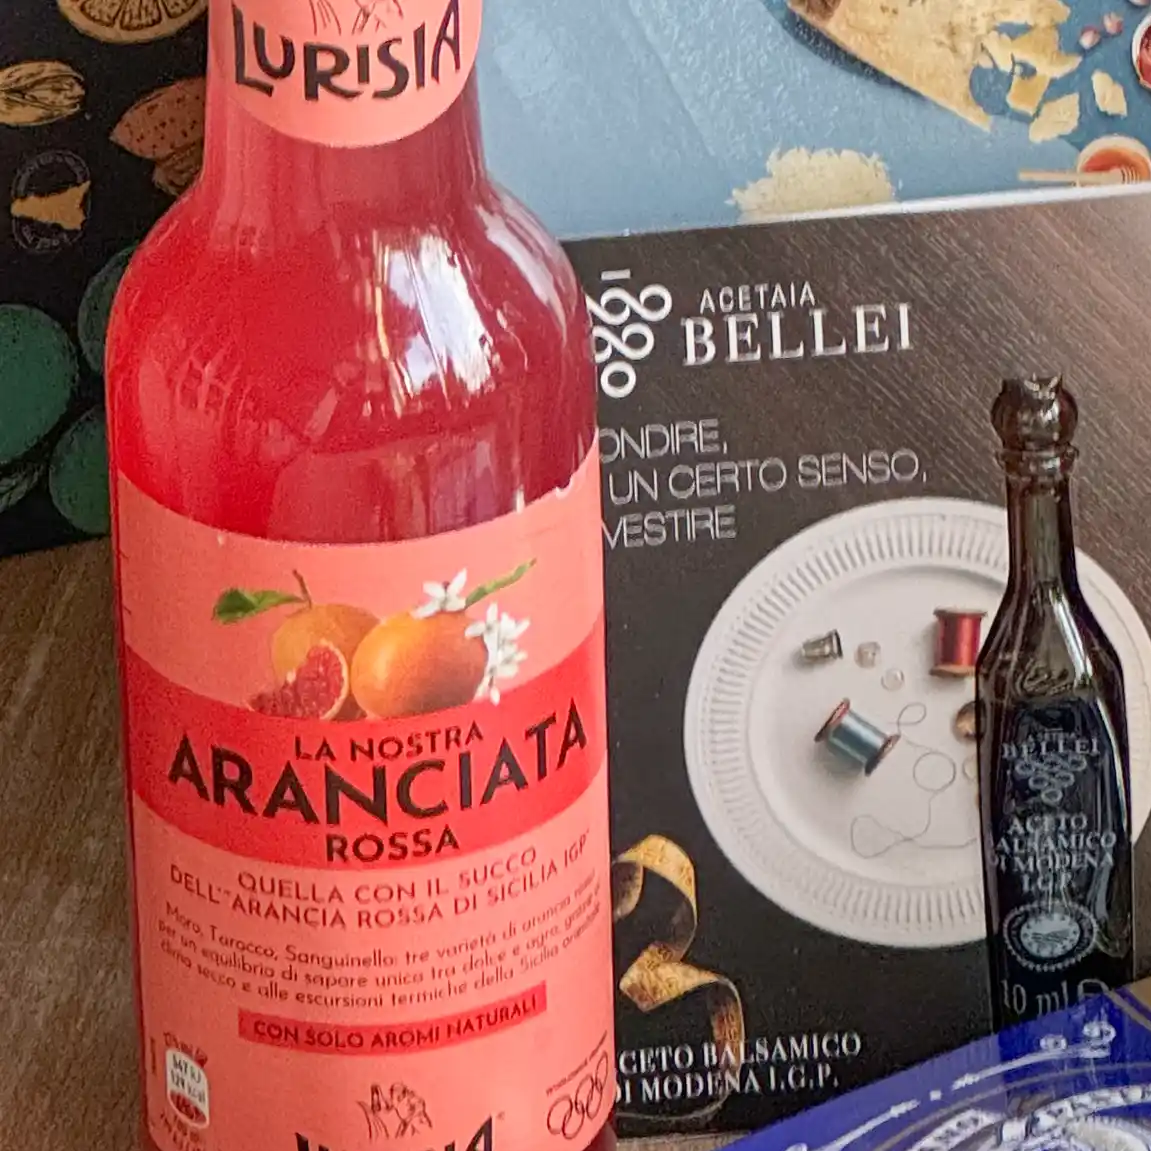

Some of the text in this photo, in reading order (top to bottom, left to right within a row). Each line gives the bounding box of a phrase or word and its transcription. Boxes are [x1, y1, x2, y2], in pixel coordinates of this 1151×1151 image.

[231, 0, 460, 101] LURISIA
[700, 280, 816, 314] ACETAIA
[681, 303, 912, 366] BELLEI
[609, 448, 927, 505] UN CERTO SENSO,
[168, 697, 588, 827] ARANCIATA
[295, 720, 484, 762] LA NOSTRA
[325, 824, 461, 864] ROSSA
[238, 847, 537, 904] QUELLA CON IL SUCCO
[358, 859, 557, 929] ROSSA DI SICILIA
[166, 901, 203, 936] Moro,
[210, 925, 279, 960] Tarocco,
[406, 951, 429, 966] tre
[503, 921, 516, 941] di
[202, 948, 275, 979] equilibrio
[282, 965, 298, 982] di
[305, 972, 367, 990] sapore
[254, 994, 537, 1049] CON SOLO AROMI NATURALI
[295, 990, 384, 1008] escursioni
[703, 1031, 862, 1069] BALSAMICO
[641, 1063, 839, 1102] MODENA I.G.P.
